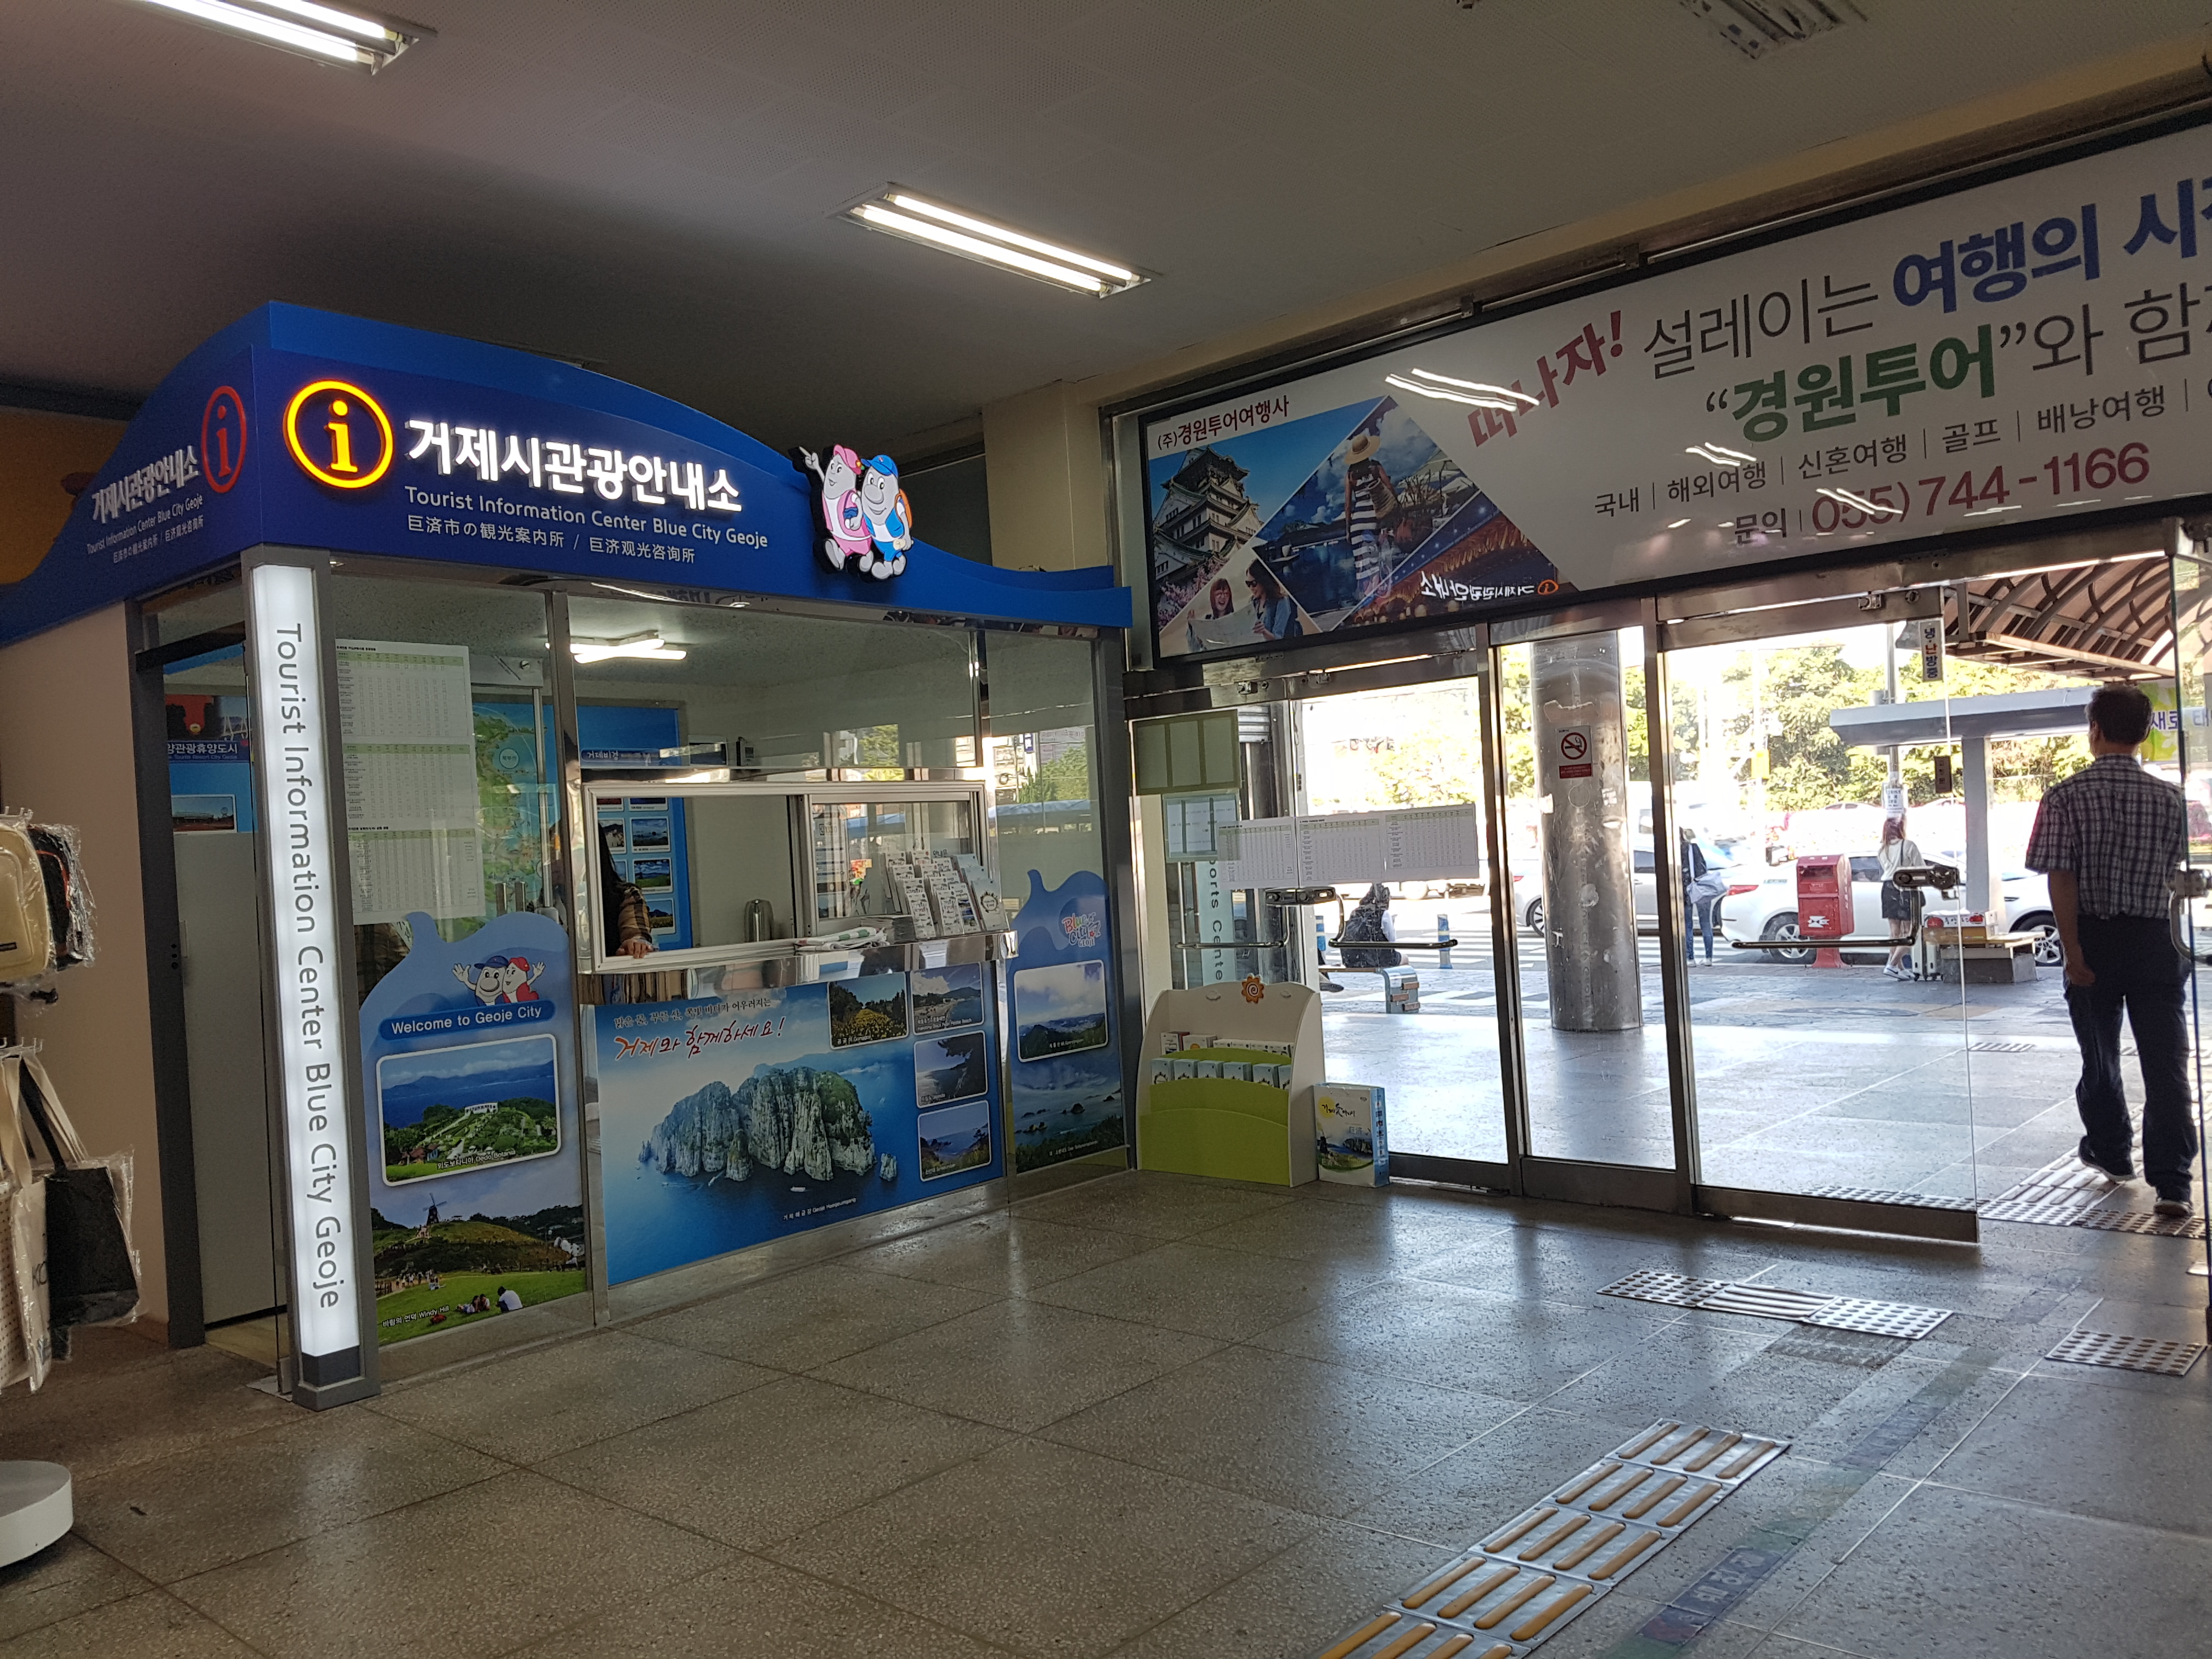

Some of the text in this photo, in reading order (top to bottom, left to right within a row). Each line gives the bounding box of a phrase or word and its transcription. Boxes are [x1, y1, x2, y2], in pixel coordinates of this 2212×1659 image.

[1466, 178, 2212, 448] 떠나자! 설레이는 여행의 시
[2124, 282, 2212, 364] 함
[1158, 394, 1290, 450] (주)경원투어여행사
[1594, 487, 1640, 517] 국내
[1667, 461, 1767, 503] 해외여행
[1798, 433, 1908, 480] 신혼여행
[1942, 419, 2001, 454] 골프
[2038, 385, 2165, 434] 배낭여행
[91, 444, 200, 524] 거제시관광안내소
[404, 417, 743, 514] 거제시관광안내소
[87, 493, 204, 555] Tourist Information Center Blue City Geoje
[405, 486, 769, 550] Tourist Information Center Blue City Geoje
[1734, 507, 1788, 546] 문의
[1062, 913, 1089, 946] Blue City
[1078, 939, 1096, 947] GEOJE
[275, 623, 345, 1308] Tourist Information Center Blue City Geoje
[391, 1005, 542, 1035] Welcome to Geoje City
[732, 997, 772, 1012] 어우러지는
[614, 1036, 681, 1062] 거제와
[404, 1313, 417, 1323] 언덕
[419, 1308, 438, 1319] Windy
[439, 1305, 450, 1313] Hill
